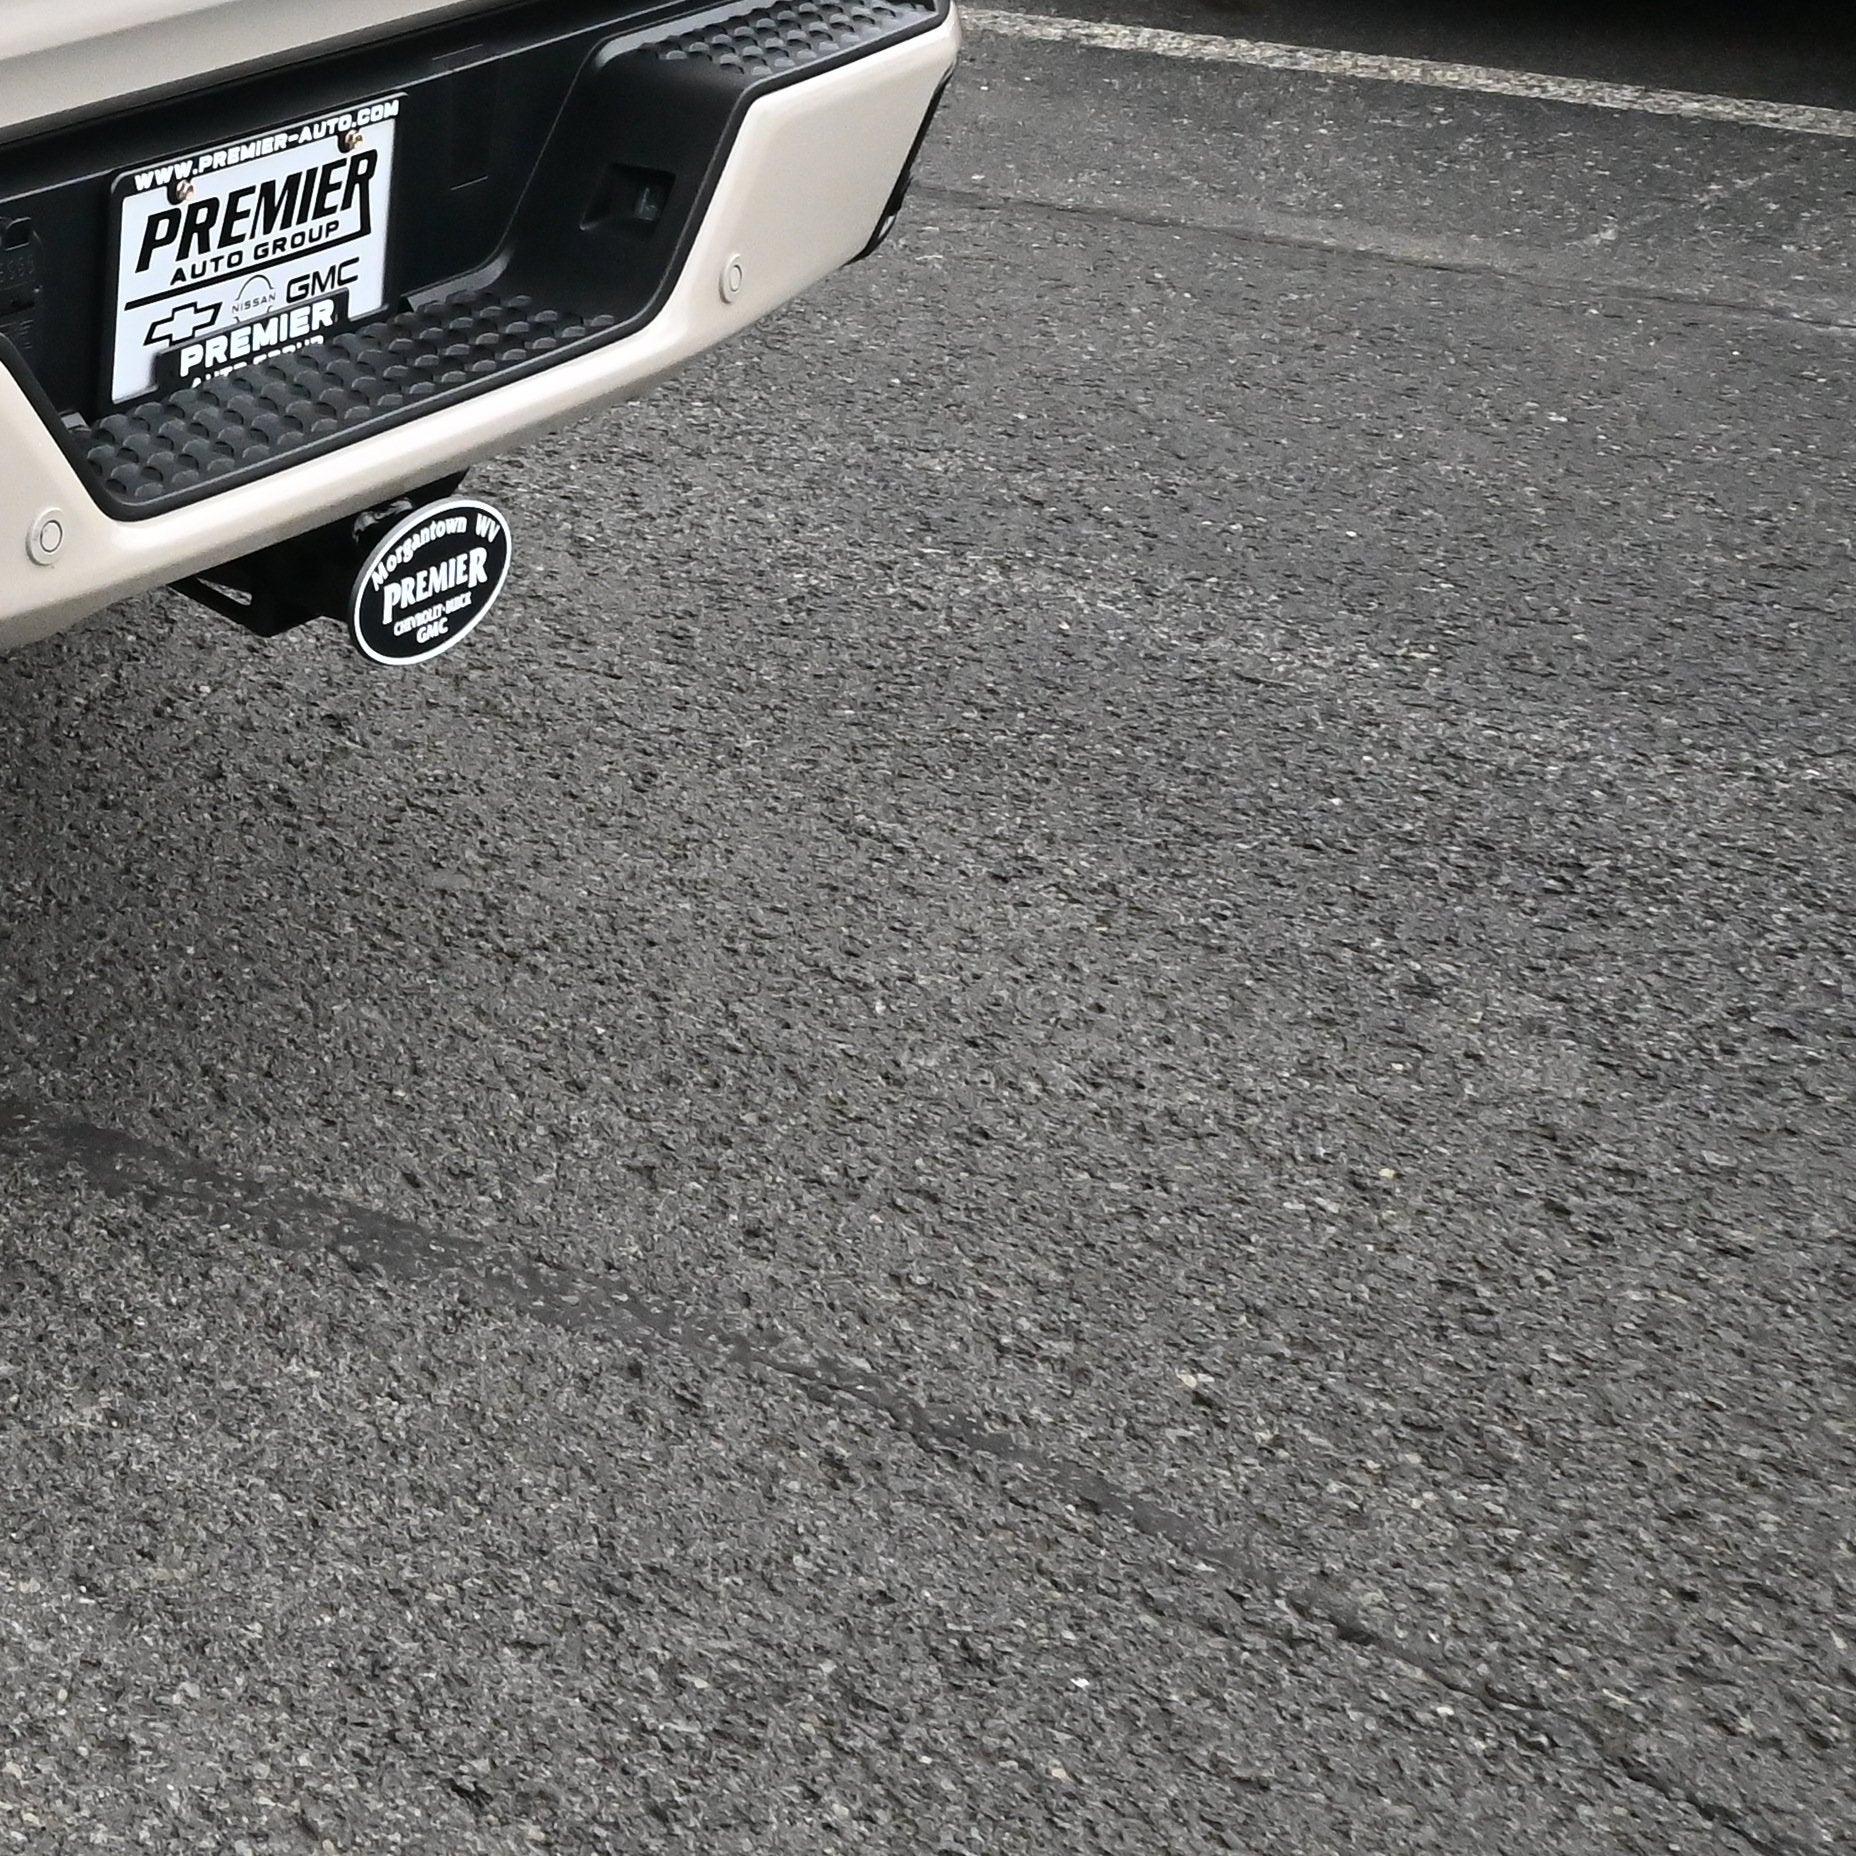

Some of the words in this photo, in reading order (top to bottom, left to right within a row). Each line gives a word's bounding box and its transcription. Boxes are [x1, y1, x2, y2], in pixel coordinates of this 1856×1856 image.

[134, 100, 399, 191] WWW.PREMIER-AUTO.COM
[135, 148, 378, 273] PREMIER
[170, 253, 243, 285] AUTO
[253, 220, 339, 260] GROUP
[286, 257, 359, 303] GMC
[180, 299, 335, 377] PREMIER
[232, 292, 276, 314] NISSAN
[371, 516, 468, 591] Morgantown
[475, 513, 500, 543] WV
[382, 547, 487, 625] PREMIER
[416, 617, 448, 643] GMC
